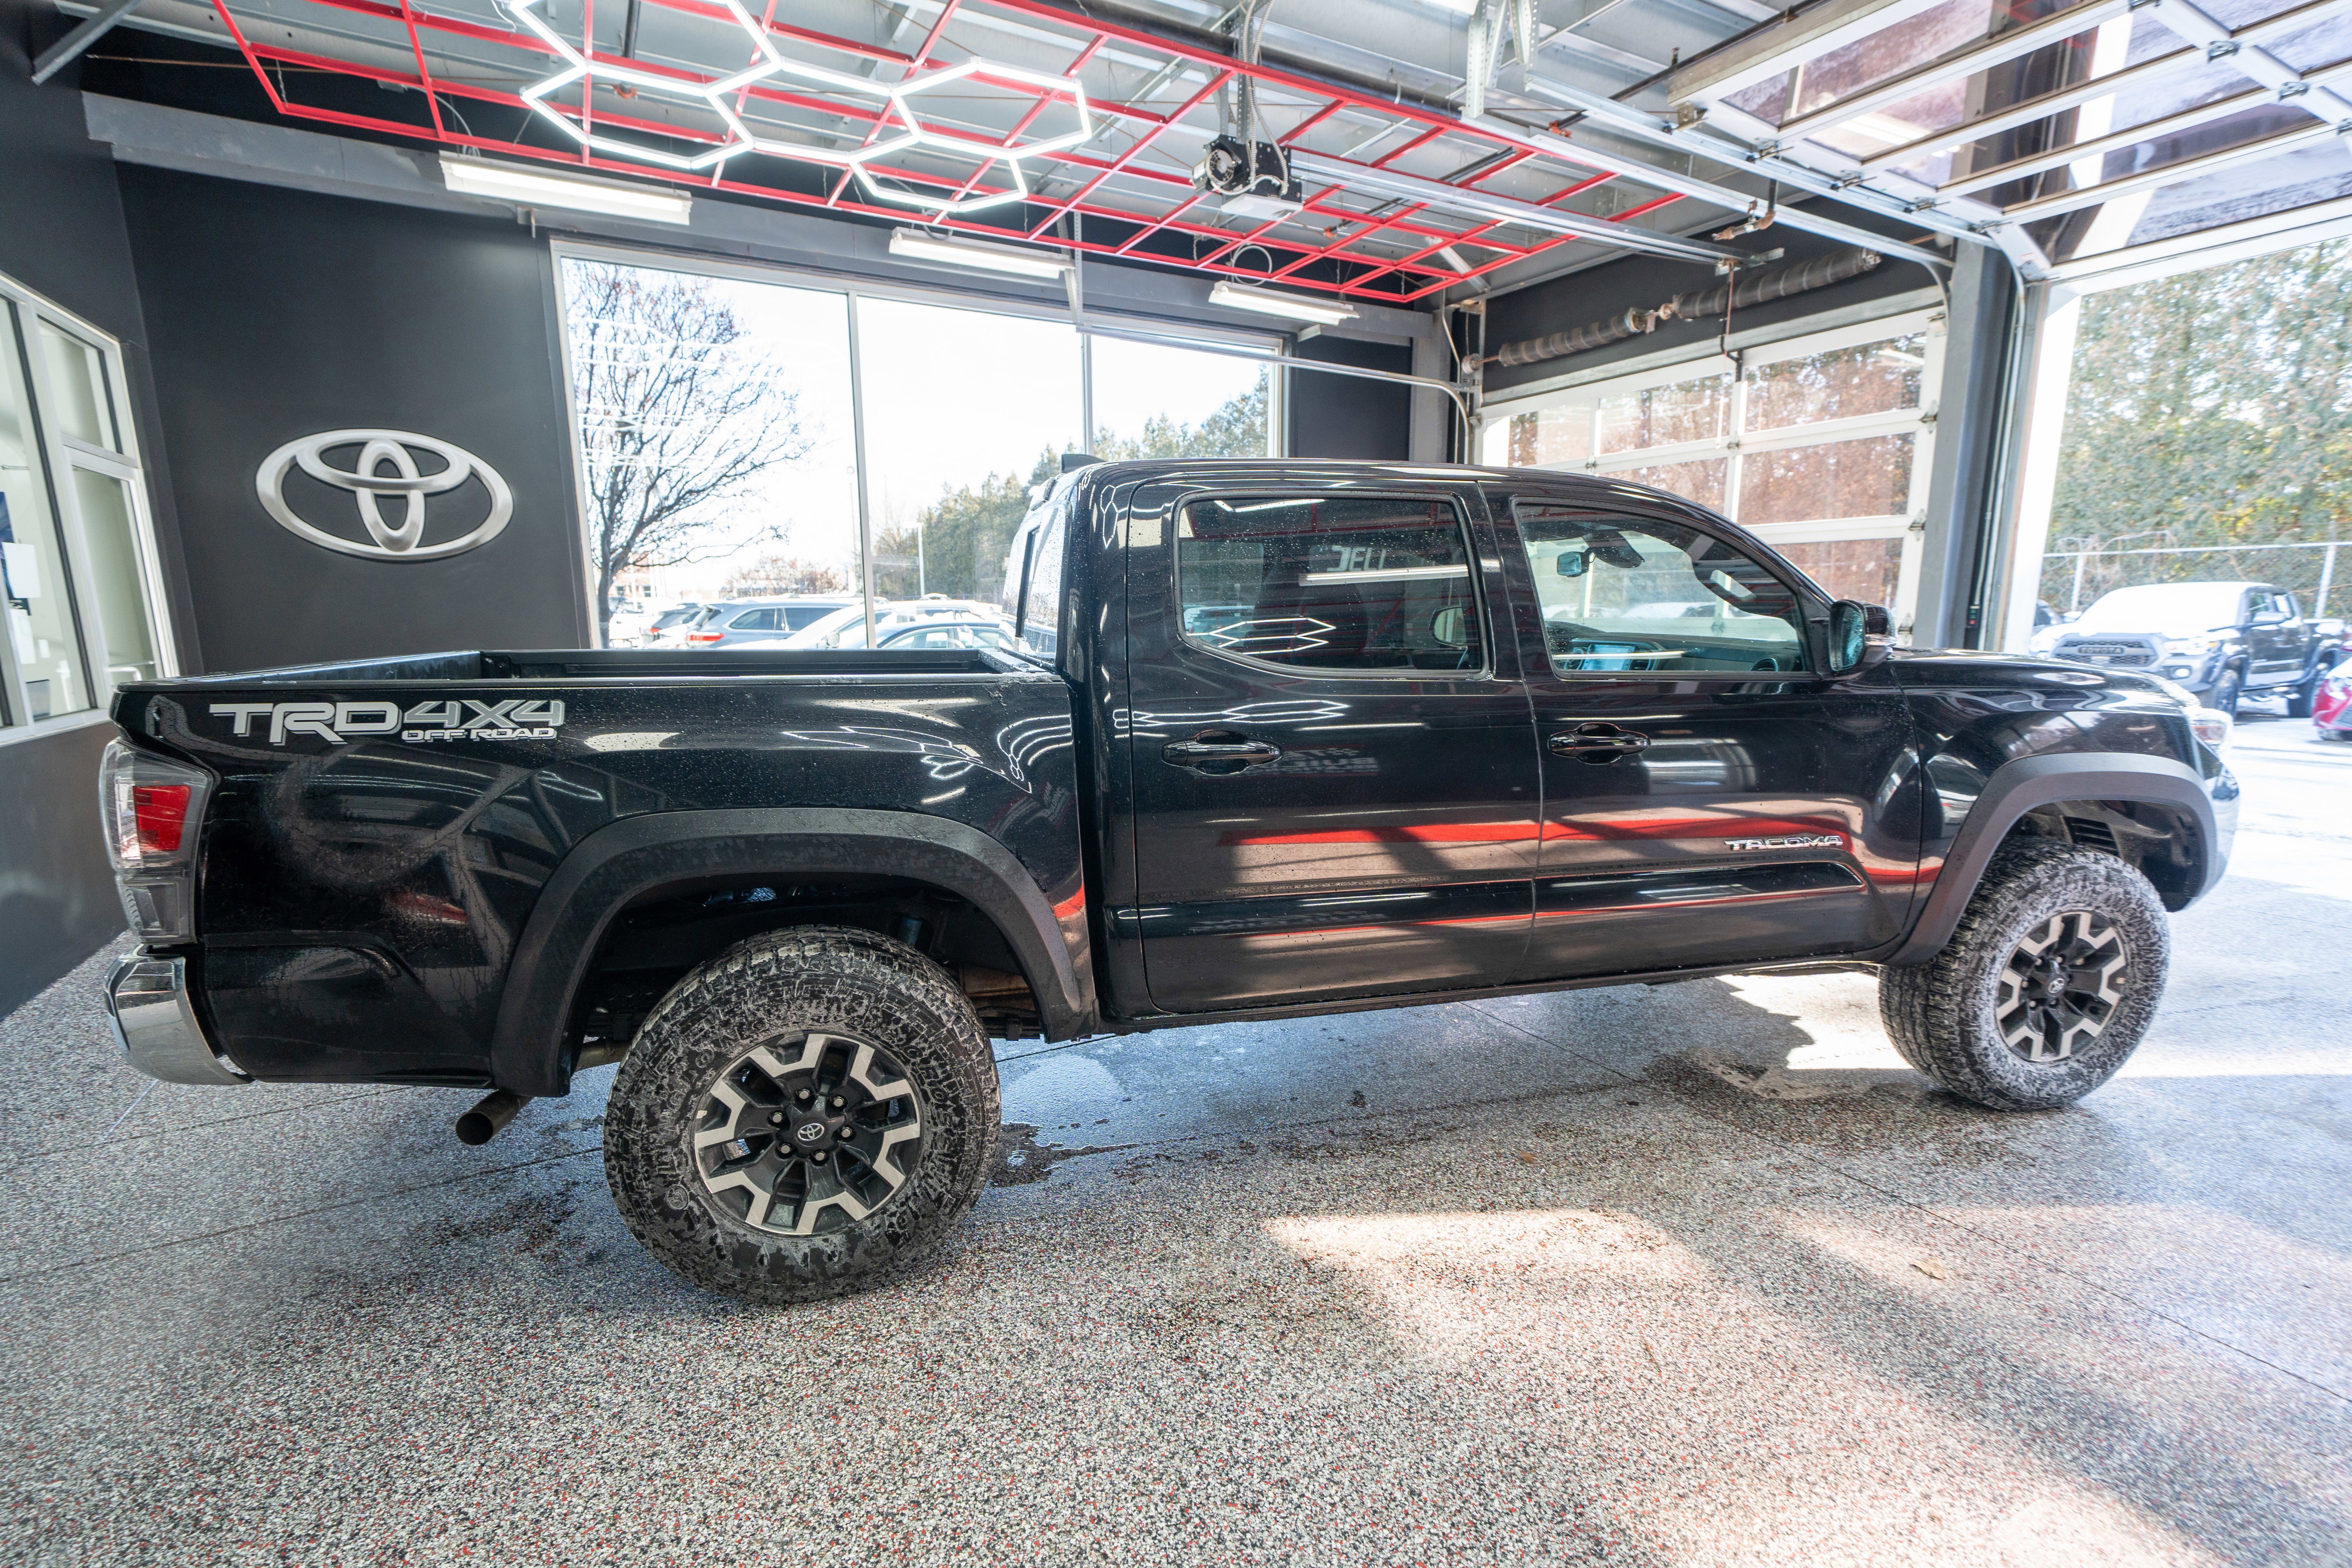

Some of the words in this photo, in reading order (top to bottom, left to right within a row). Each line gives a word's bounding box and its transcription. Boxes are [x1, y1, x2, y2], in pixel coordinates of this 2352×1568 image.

[209, 702, 402, 746] TRD
[403, 700, 565, 728] 4X4
[470, 728, 557, 741] ROAD
[1724, 835, 1843, 851] TACOMA
